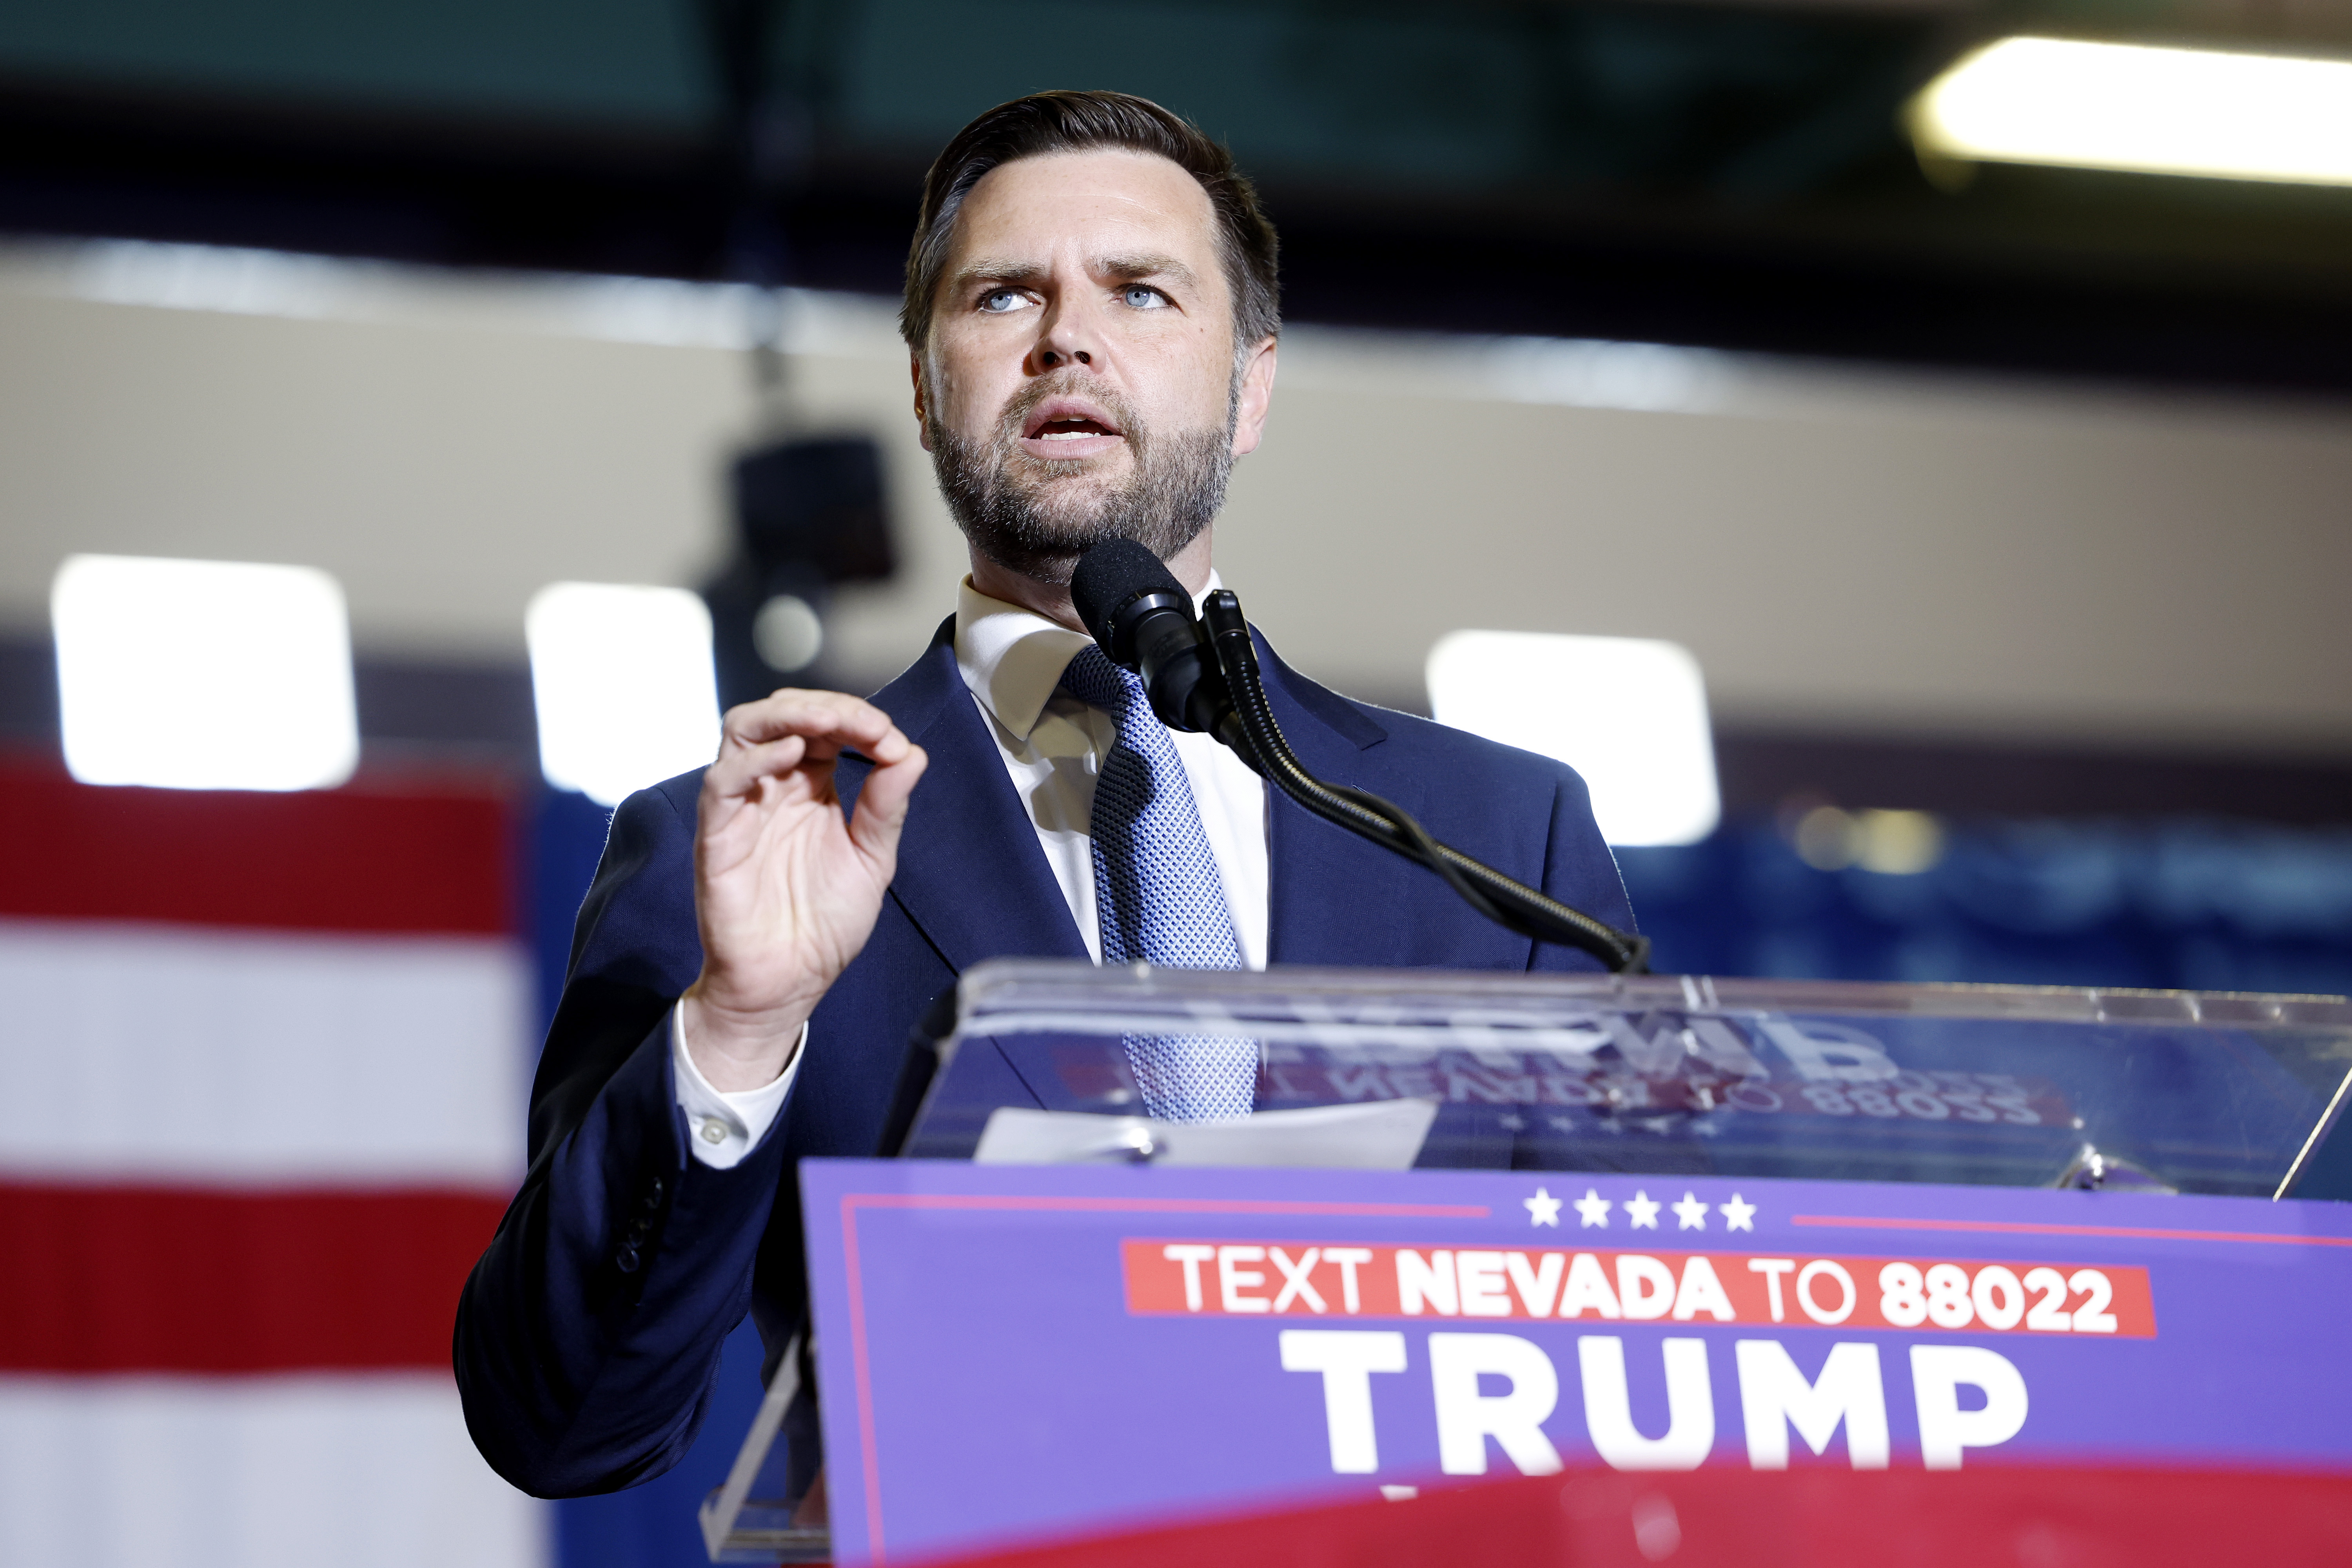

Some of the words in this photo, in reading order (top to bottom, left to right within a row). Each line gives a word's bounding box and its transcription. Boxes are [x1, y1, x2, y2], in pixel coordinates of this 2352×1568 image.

[1163, 1244, 1372, 1314] TEXT
[1395, 1249, 1737, 1321] NEVADA
[1747, 1258, 1857, 1325] TO
[1878, 1261, 2118, 1333] 88022
[1278, 1329, 2029, 1476] TRUMP
